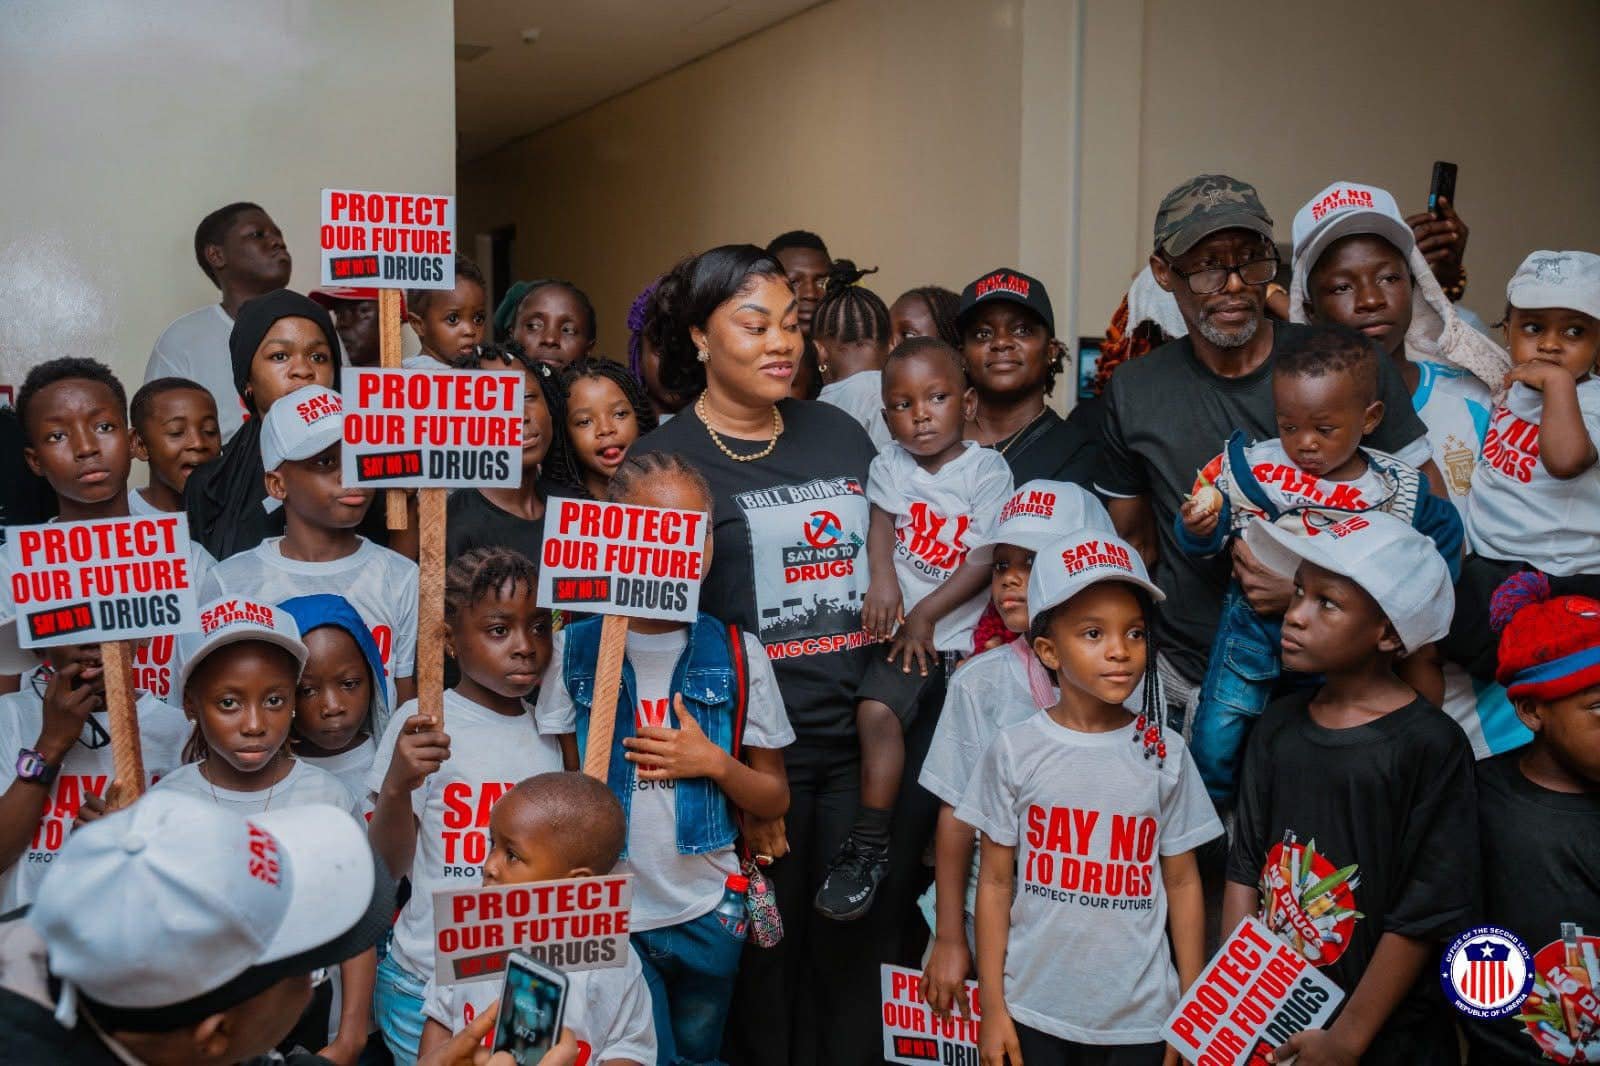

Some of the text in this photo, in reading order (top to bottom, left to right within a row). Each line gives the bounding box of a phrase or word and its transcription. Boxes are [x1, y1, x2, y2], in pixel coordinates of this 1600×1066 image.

[331, 192, 448, 226] PROTECT
[1312, 189, 1372, 212] SAY NO
[1330, 198, 1374, 209] DRUGS
[321, 224, 452, 254] OUR FUTURE
[383, 255, 444, 282] DRUGS
[296, 393, 328, 415] SAY
[359, 373, 520, 411] PROTECT
[344, 414, 405, 445] OUR
[414, 415, 523, 447] FUTURE
[429, 449, 510, 481] DRUGS
[745, 487, 788, 509] BALL
[789, 478, 853, 504] BOUNCE
[1029, 490, 1056, 506] NO
[560, 501, 702, 546] PROTECT
[907, 502, 947, 540] AY
[19, 518, 178, 567] PROTECT
[543, 538, 702, 580] OUR FUTURE
[787, 545, 854, 563] SAY NO TO
[1062, 540, 1130, 564] SAY NO
[785, 560, 854, 584] DRUGS
[914, 560, 940, 578] OUR
[1065, 553, 1132, 574] TO DRUGS
[12, 558, 189, 604] OUR FUTURE
[615, 577, 689, 612] DRUGS
[99, 593, 181, 631] DRUGS
[201, 599, 273, 625] SAY NO
[202, 618, 219, 634] TO
[223, 610, 275, 628] DRUGS
[443, 782, 516, 829] SA
[441, 831, 486, 864] TO
[1026, 804, 1157, 863] SAY NO
[1025, 850, 1153, 897] TO DRUGS
[452, 879, 626, 923] PROTECT
[1024, 883, 1153, 910] PROTECT OUR FUTURE
[1270, 863, 1323, 949] NO DRUGS
[438, 911, 629, 953] OUR FUTURE
[1171, 922, 1273, 1050] PROTECT
[1229, 945, 1307, 1037] FUTURE
[1547, 965, 1580, 996] NO
[884, 1001, 981, 1045] OUR FUTU
[1265, 976, 1330, 1046] DRUGS
[942, 1041, 980, 1066] DRU
